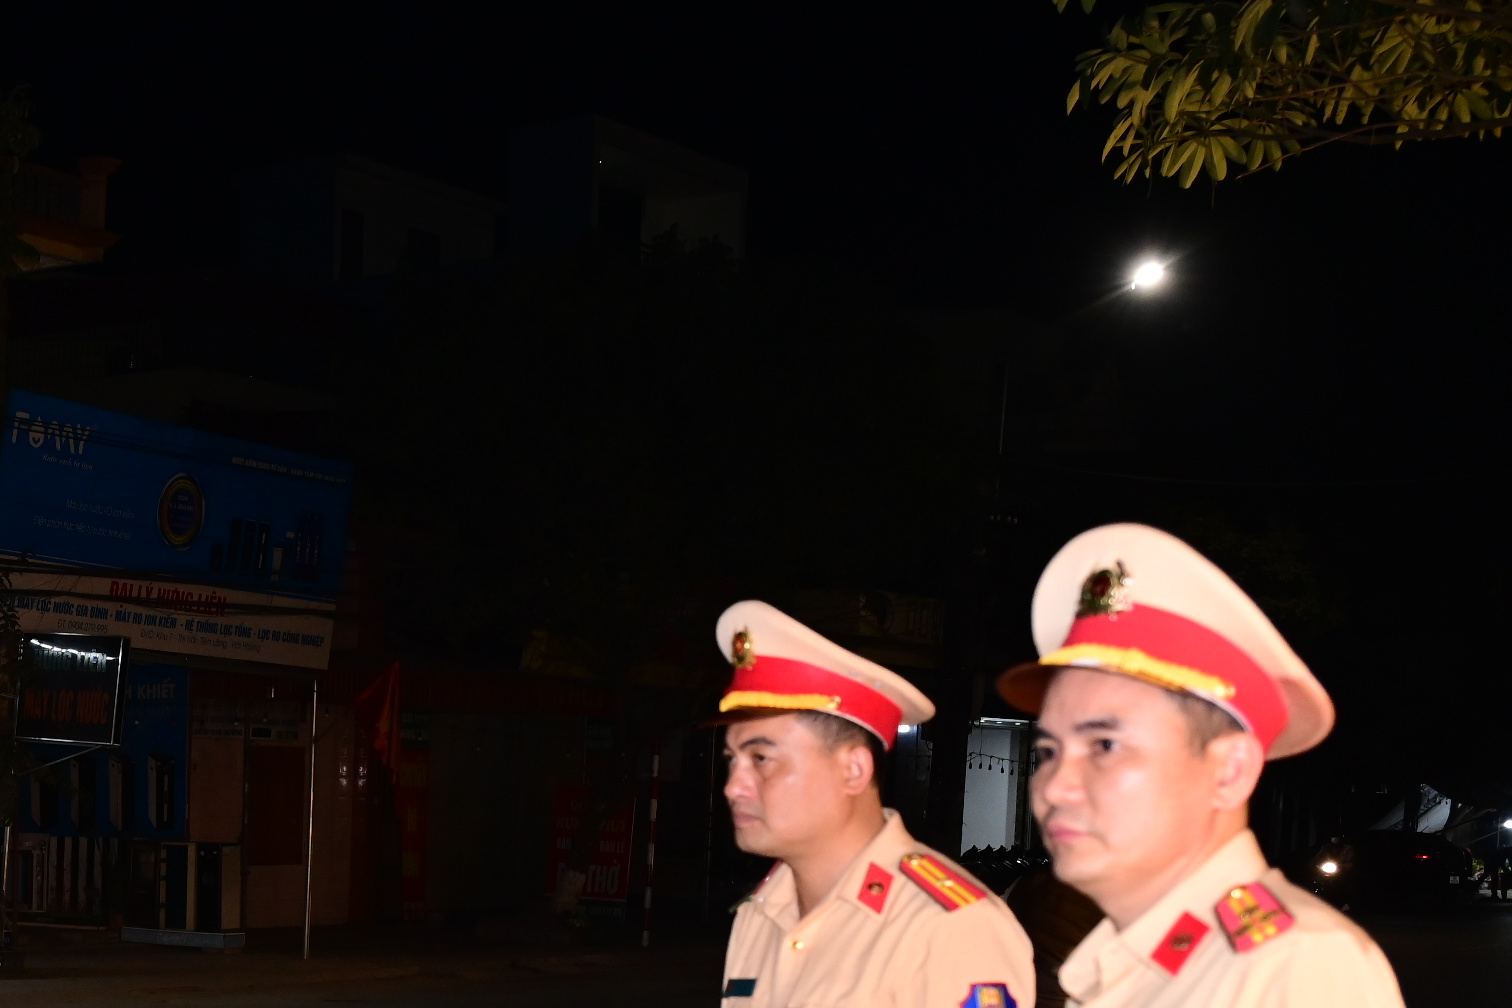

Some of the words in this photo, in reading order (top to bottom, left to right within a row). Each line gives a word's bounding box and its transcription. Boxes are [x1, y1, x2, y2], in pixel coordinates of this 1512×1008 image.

[36, 600, 52, 615] LỌC
[53, 600, 74, 615] NƯỚC
[75, 604, 88, 618] GIA
[89, 604, 109, 620] ĐÌNH
[114, 606, 131, 623] MÁY
[132, 611, 143, 625] RO
[143, 613, 157, 627] ION
[184, 617, 195, 635] HỆ
[219, 622, 233, 639] LỌC
[257, 627, 270, 642] LỌC
[271, 629, 281, 642] RO
[301, 633, 325, 649] NGHIỆP
[137, 677, 176, 700] KHIẾT
